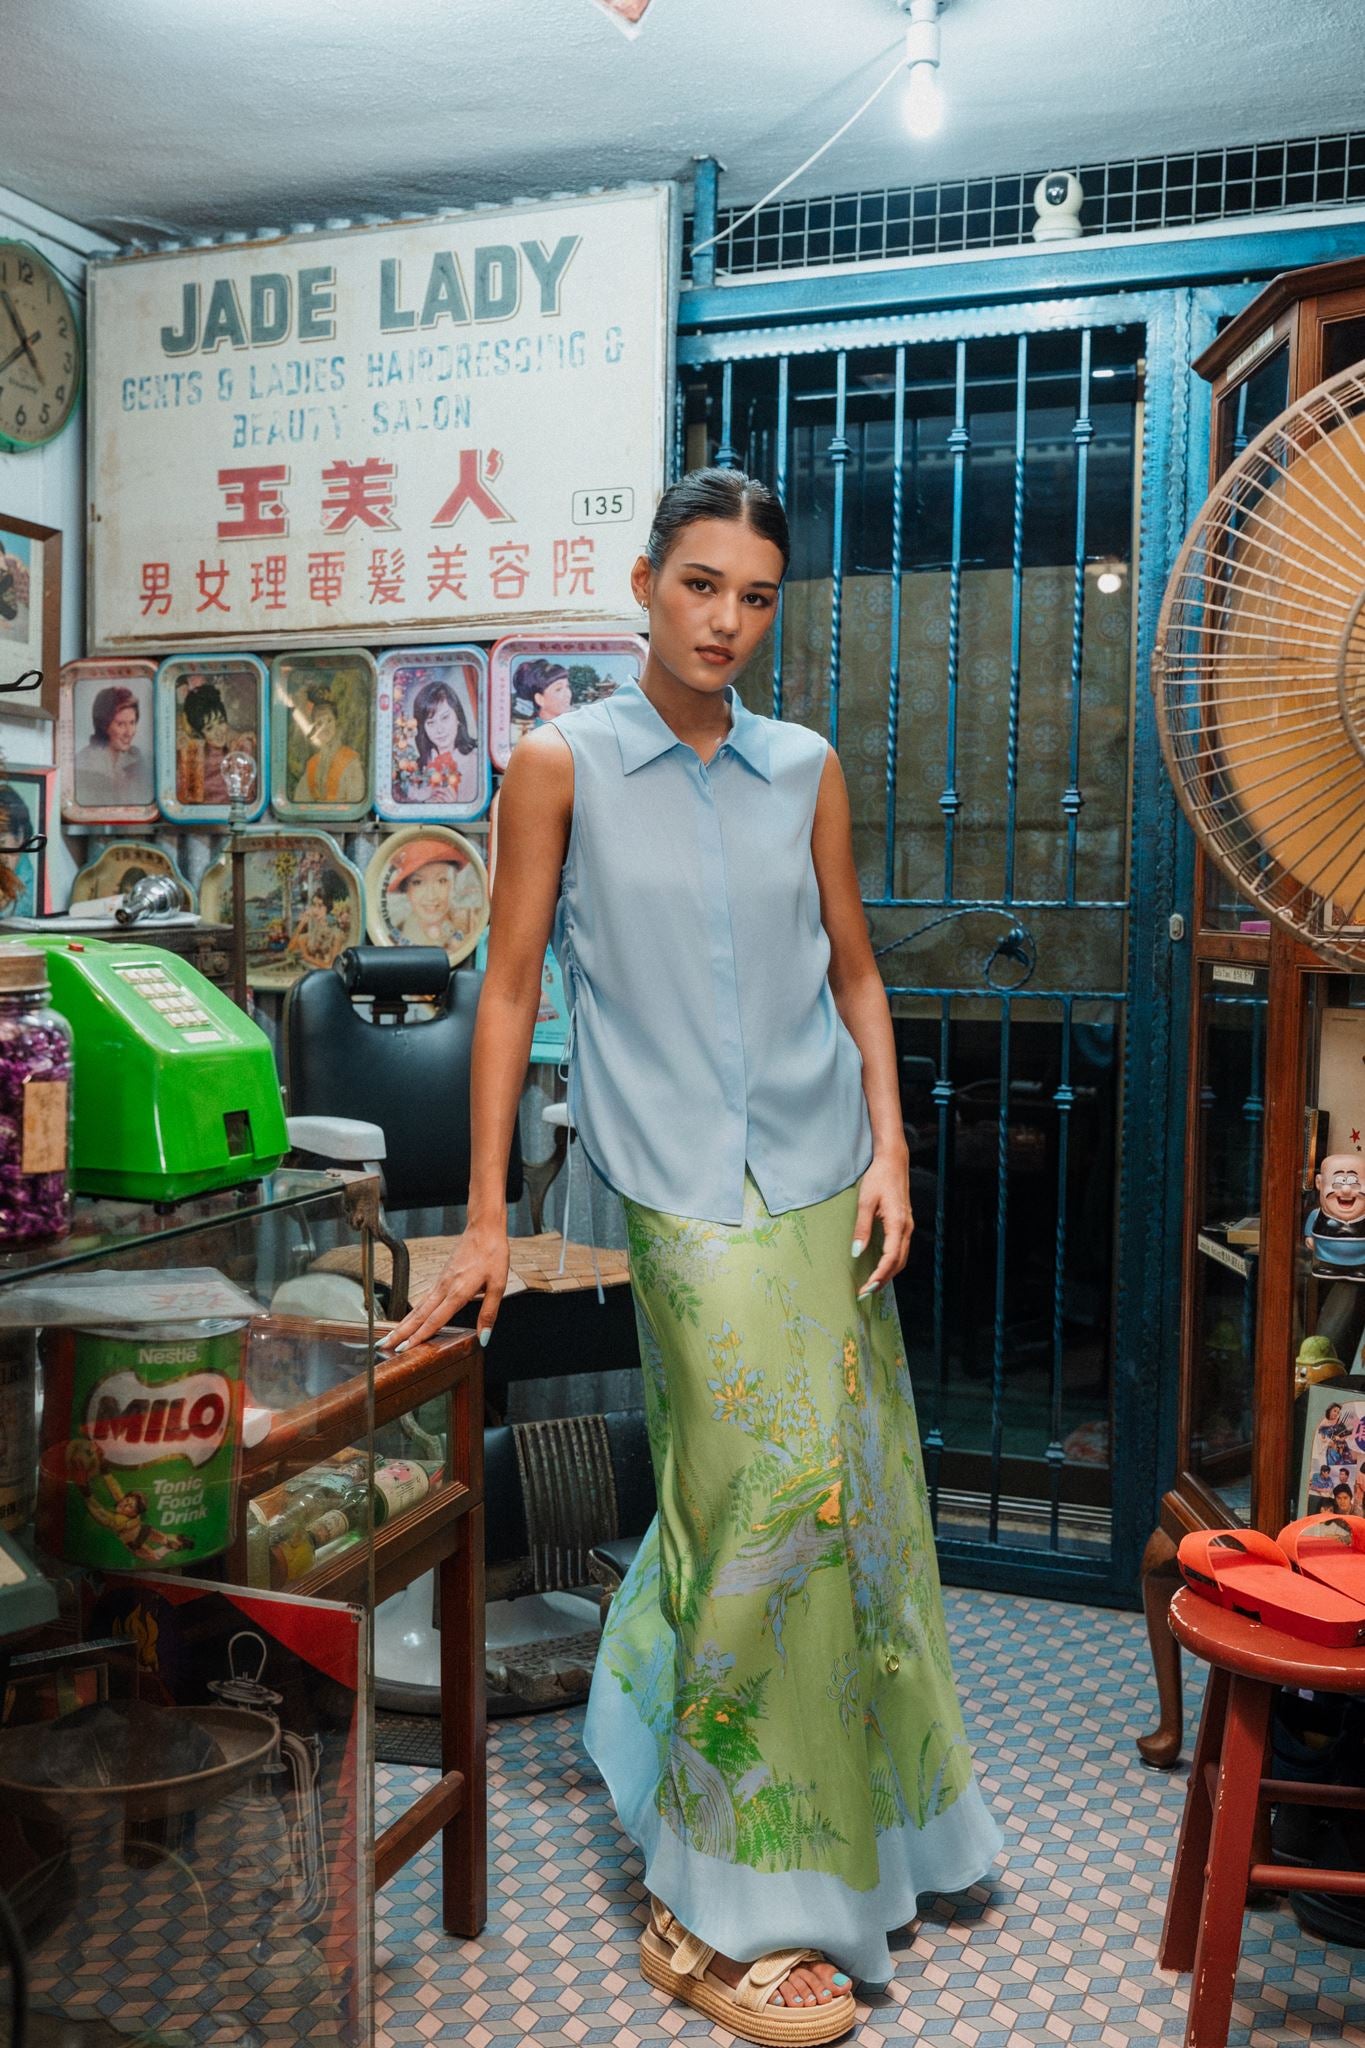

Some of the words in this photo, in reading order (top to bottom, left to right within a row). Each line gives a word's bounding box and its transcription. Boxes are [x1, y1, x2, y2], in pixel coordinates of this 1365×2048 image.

[160, 266, 336, 357] JADE
[380, 235, 583, 333] LADY
[121, 370, 203, 412] GENTS
[216, 367, 235, 401] &
[249, 358, 345, 399] LADIES
[604, 326, 625, 364] &
[232, 404, 349, 449] BEAUTY
[372, 394, 472, 435] SALON
[582, 493, 624, 516] 135
[139, 536, 596, 616] 男女理電髮美容院
[94, 1393, 224, 1444] MILO
[153, 1477, 203, 1495] Tonic
[157, 1490, 204, 1510] Food
[160, 1507, 209, 1527] Drink
